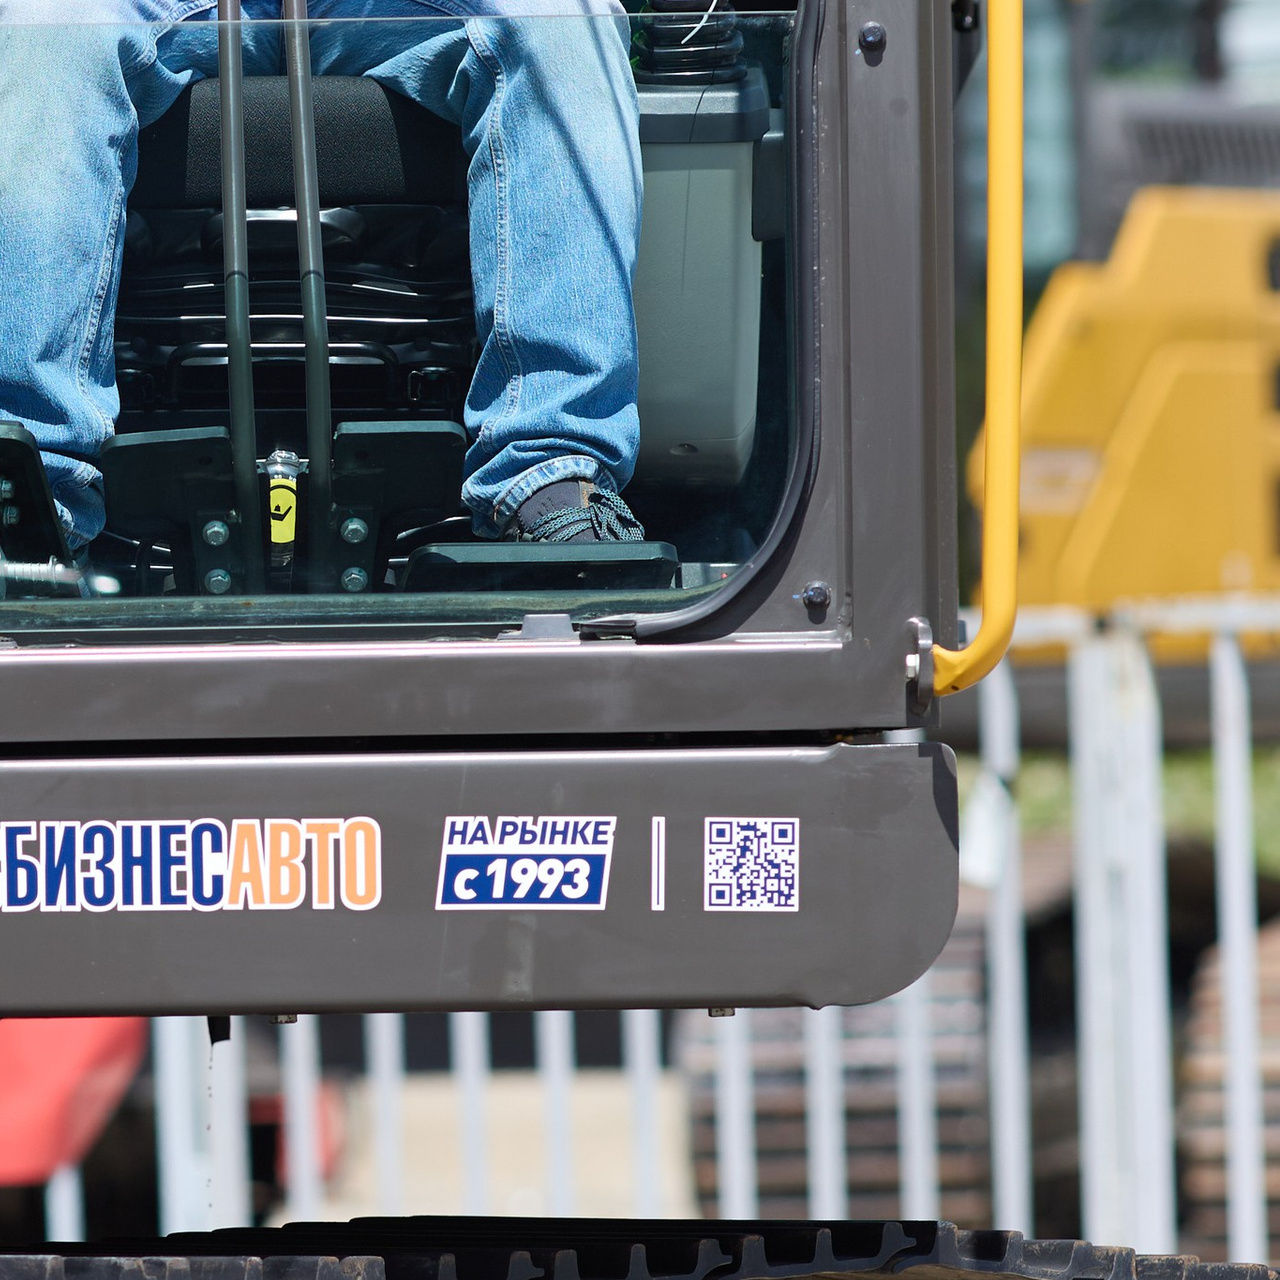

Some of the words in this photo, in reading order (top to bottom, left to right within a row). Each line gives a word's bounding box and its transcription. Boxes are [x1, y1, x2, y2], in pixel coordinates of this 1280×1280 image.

[447, 820, 489, 845] НА
[498, 820, 612, 845] РЫНКЕ
[486, 858, 591, 899] 1993
